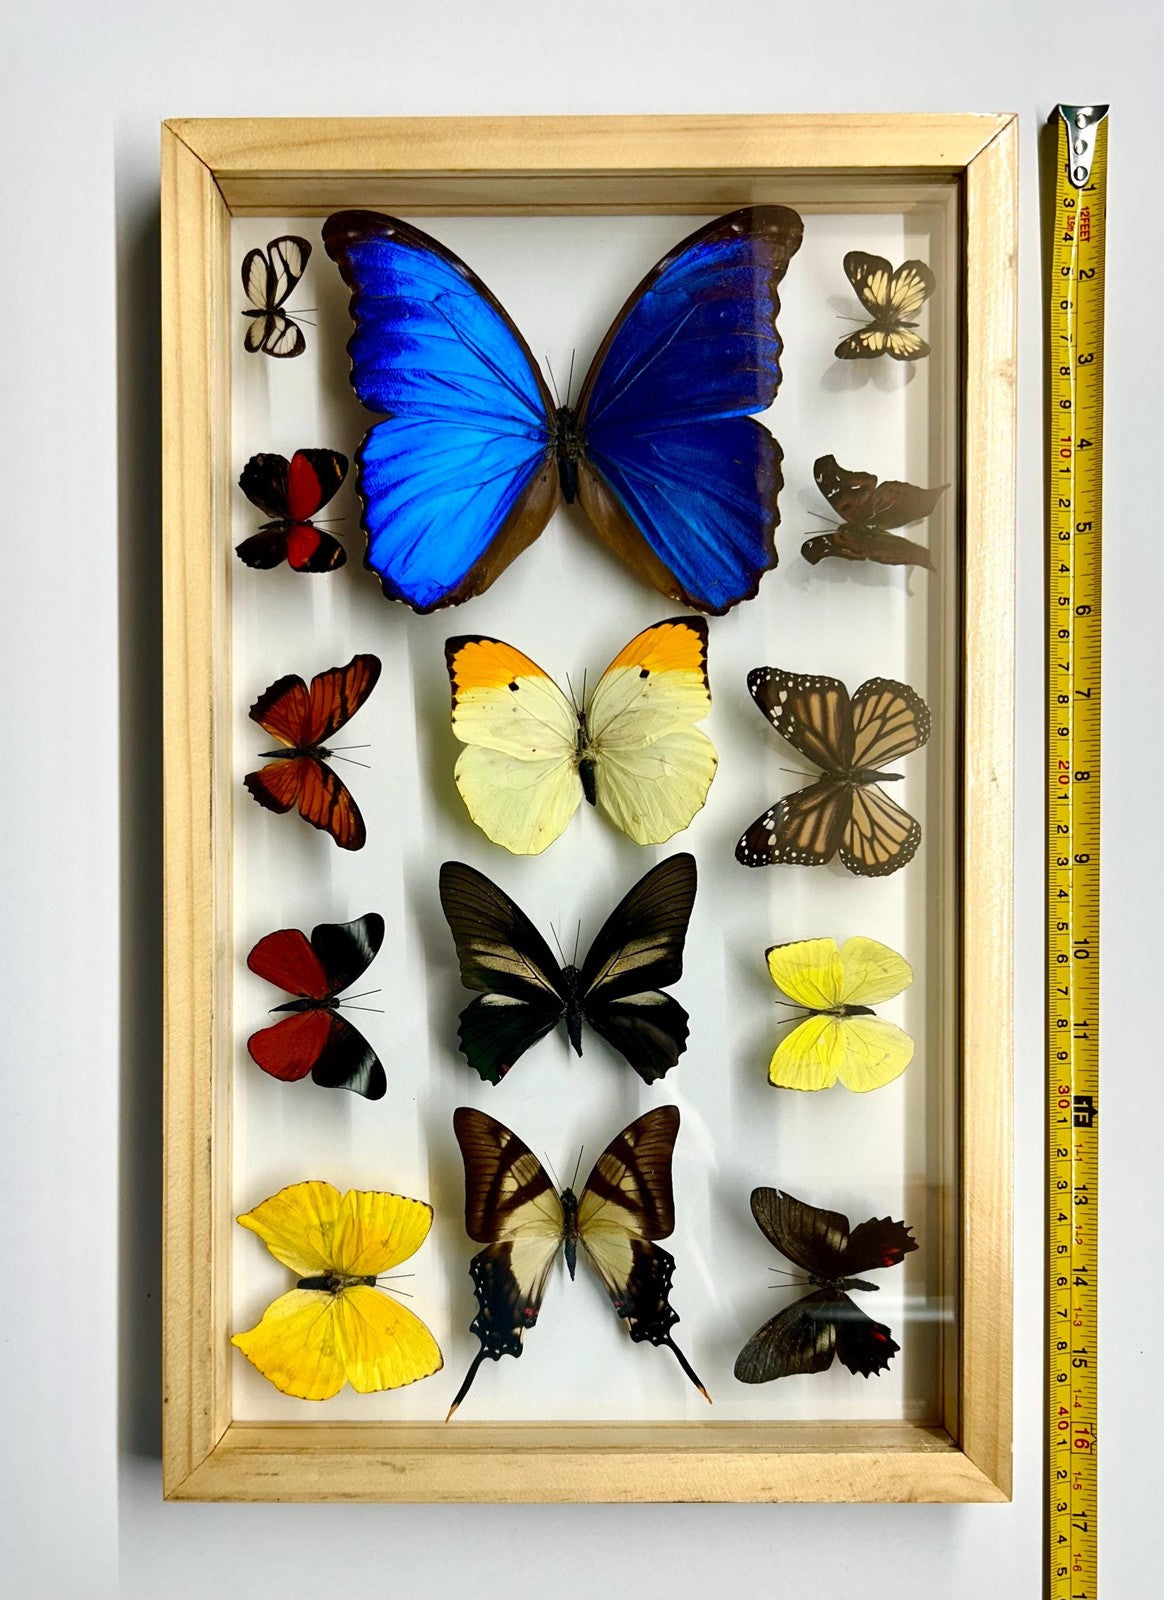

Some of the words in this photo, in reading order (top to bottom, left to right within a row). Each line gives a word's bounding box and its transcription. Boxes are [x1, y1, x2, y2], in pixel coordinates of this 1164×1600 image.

[1063, 198, 1075, 208] 3
[1080, 207, 1090, 243] 12FEET
[1062, 233, 1073, 242] 4
[1061, 267, 1073, 276] 5
[1079, 268, 1095, 280] 2
[1060, 300, 1073, 310] 6
[1060, 334, 1072, 342] 7
[1078, 353, 1094, 364] 3
[1060, 367, 1070, 376] 8
[1060, 400, 1071, 409] 9
[1060, 436, 1072, 458] 10
[1077, 438, 1093, 449] 4
[1059, 498, 1071, 508] 2
[1076, 522, 1092, 532] 5
[1059, 531, 1070, 541] 3
[1059, 564, 1070, 573] 4
[1058, 597, 1070, 606] 5
[1076, 605, 1091, 616] 6
[1058, 629, 1070, 638] 6
[1058, 662, 1069, 671] 7
[1075, 688, 1091, 698] 7
[1058, 695, 1069, 704] 8
[1058, 727, 1069, 736] 9
[1058, 761, 1070, 785] 20
[1075, 771, 1090, 781] 8
[1057, 824, 1069, 834] 2
[1057, 857, 1069, 866] 3
[1074, 854, 1090, 864] 9
[1057, 889, 1069, 898] 4
[1057, 922, 1068, 931] 5
[1074, 938, 1089, 960] 10
[1057, 954, 1068, 963] 6
[1057, 986, 1068, 996] 7
[1057, 1019, 1068, 1028] 8
[1074, 1020, 1089, 1039] 11
[1057, 1051, 1068, 1060] 9
[1058, 1085, 1070, 1109] 30
[1073, 1101, 1089, 1123] 1F
[1057, 1148, 1068, 1158] 2
[1057, 1180, 1068, 1190] 3
[1074, 1184, 1088, 1206] 13
[1057, 1212, 1068, 1222] 4
[1057, 1245, 1067, 1254] 5
[1057, 1277, 1068, 1286] 6
[1073, 1266, 1088, 1287] 14
[1057, 1309, 1067, 1318] 7
[1057, 1341, 1068, 1350] 8
[1072, 1348, 1087, 1368] 15
[1057, 1373, 1067, 1382] 9
[1058, 1406, 1069, 1430] 40
[1074, 1428, 1090, 1449] 16
[1057, 1470, 1067, 1479] 2
[1057, 1503, 1067, 1512] 3
[1073, 1511, 1088, 1533] 17
[1057, 1535, 1068, 1544] 4
[1057, 1567, 1067, 1576] 5
